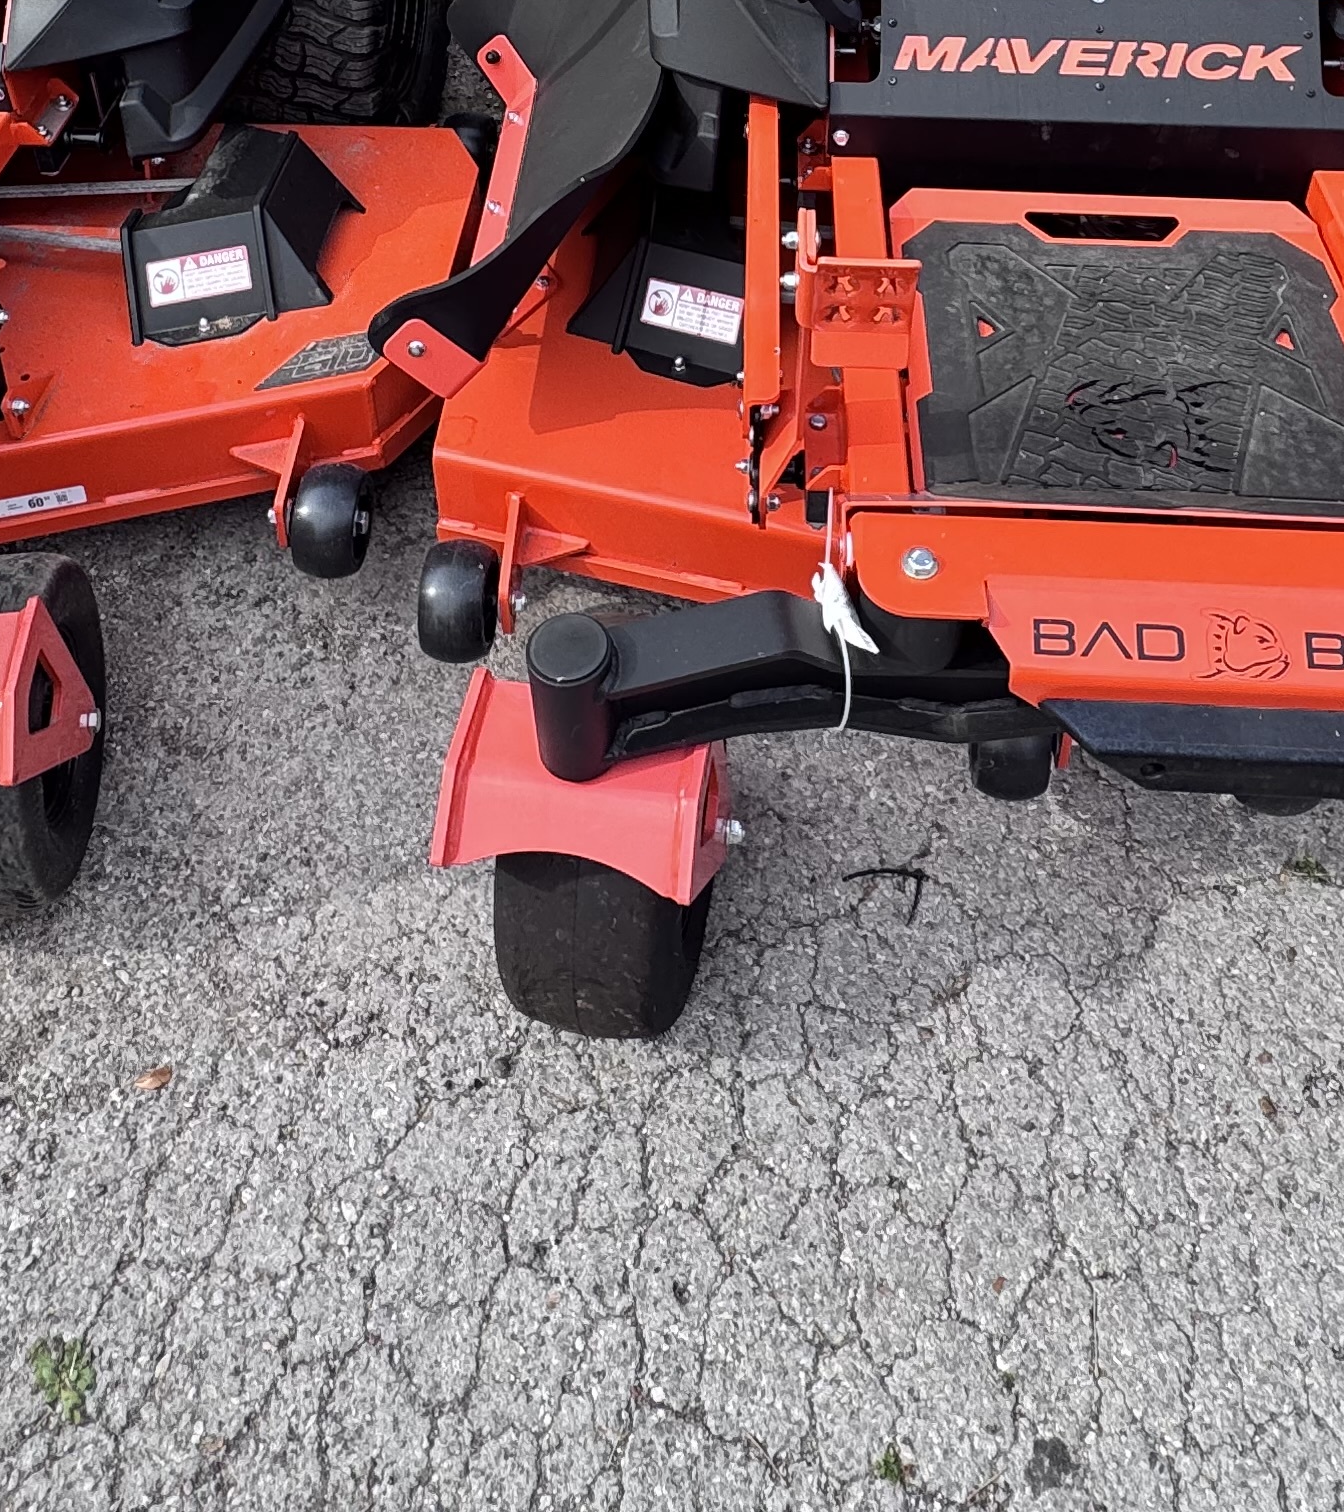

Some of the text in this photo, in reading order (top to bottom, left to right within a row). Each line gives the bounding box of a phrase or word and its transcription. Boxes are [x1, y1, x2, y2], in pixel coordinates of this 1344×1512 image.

[893, 35, 1303, 82] MAVERICK
[199, 248, 244, 267] DANGER
[696, 291, 740, 313] DANGER
[28, 496, 44, 509] 60
[1033, 617, 1185, 662] BAD
